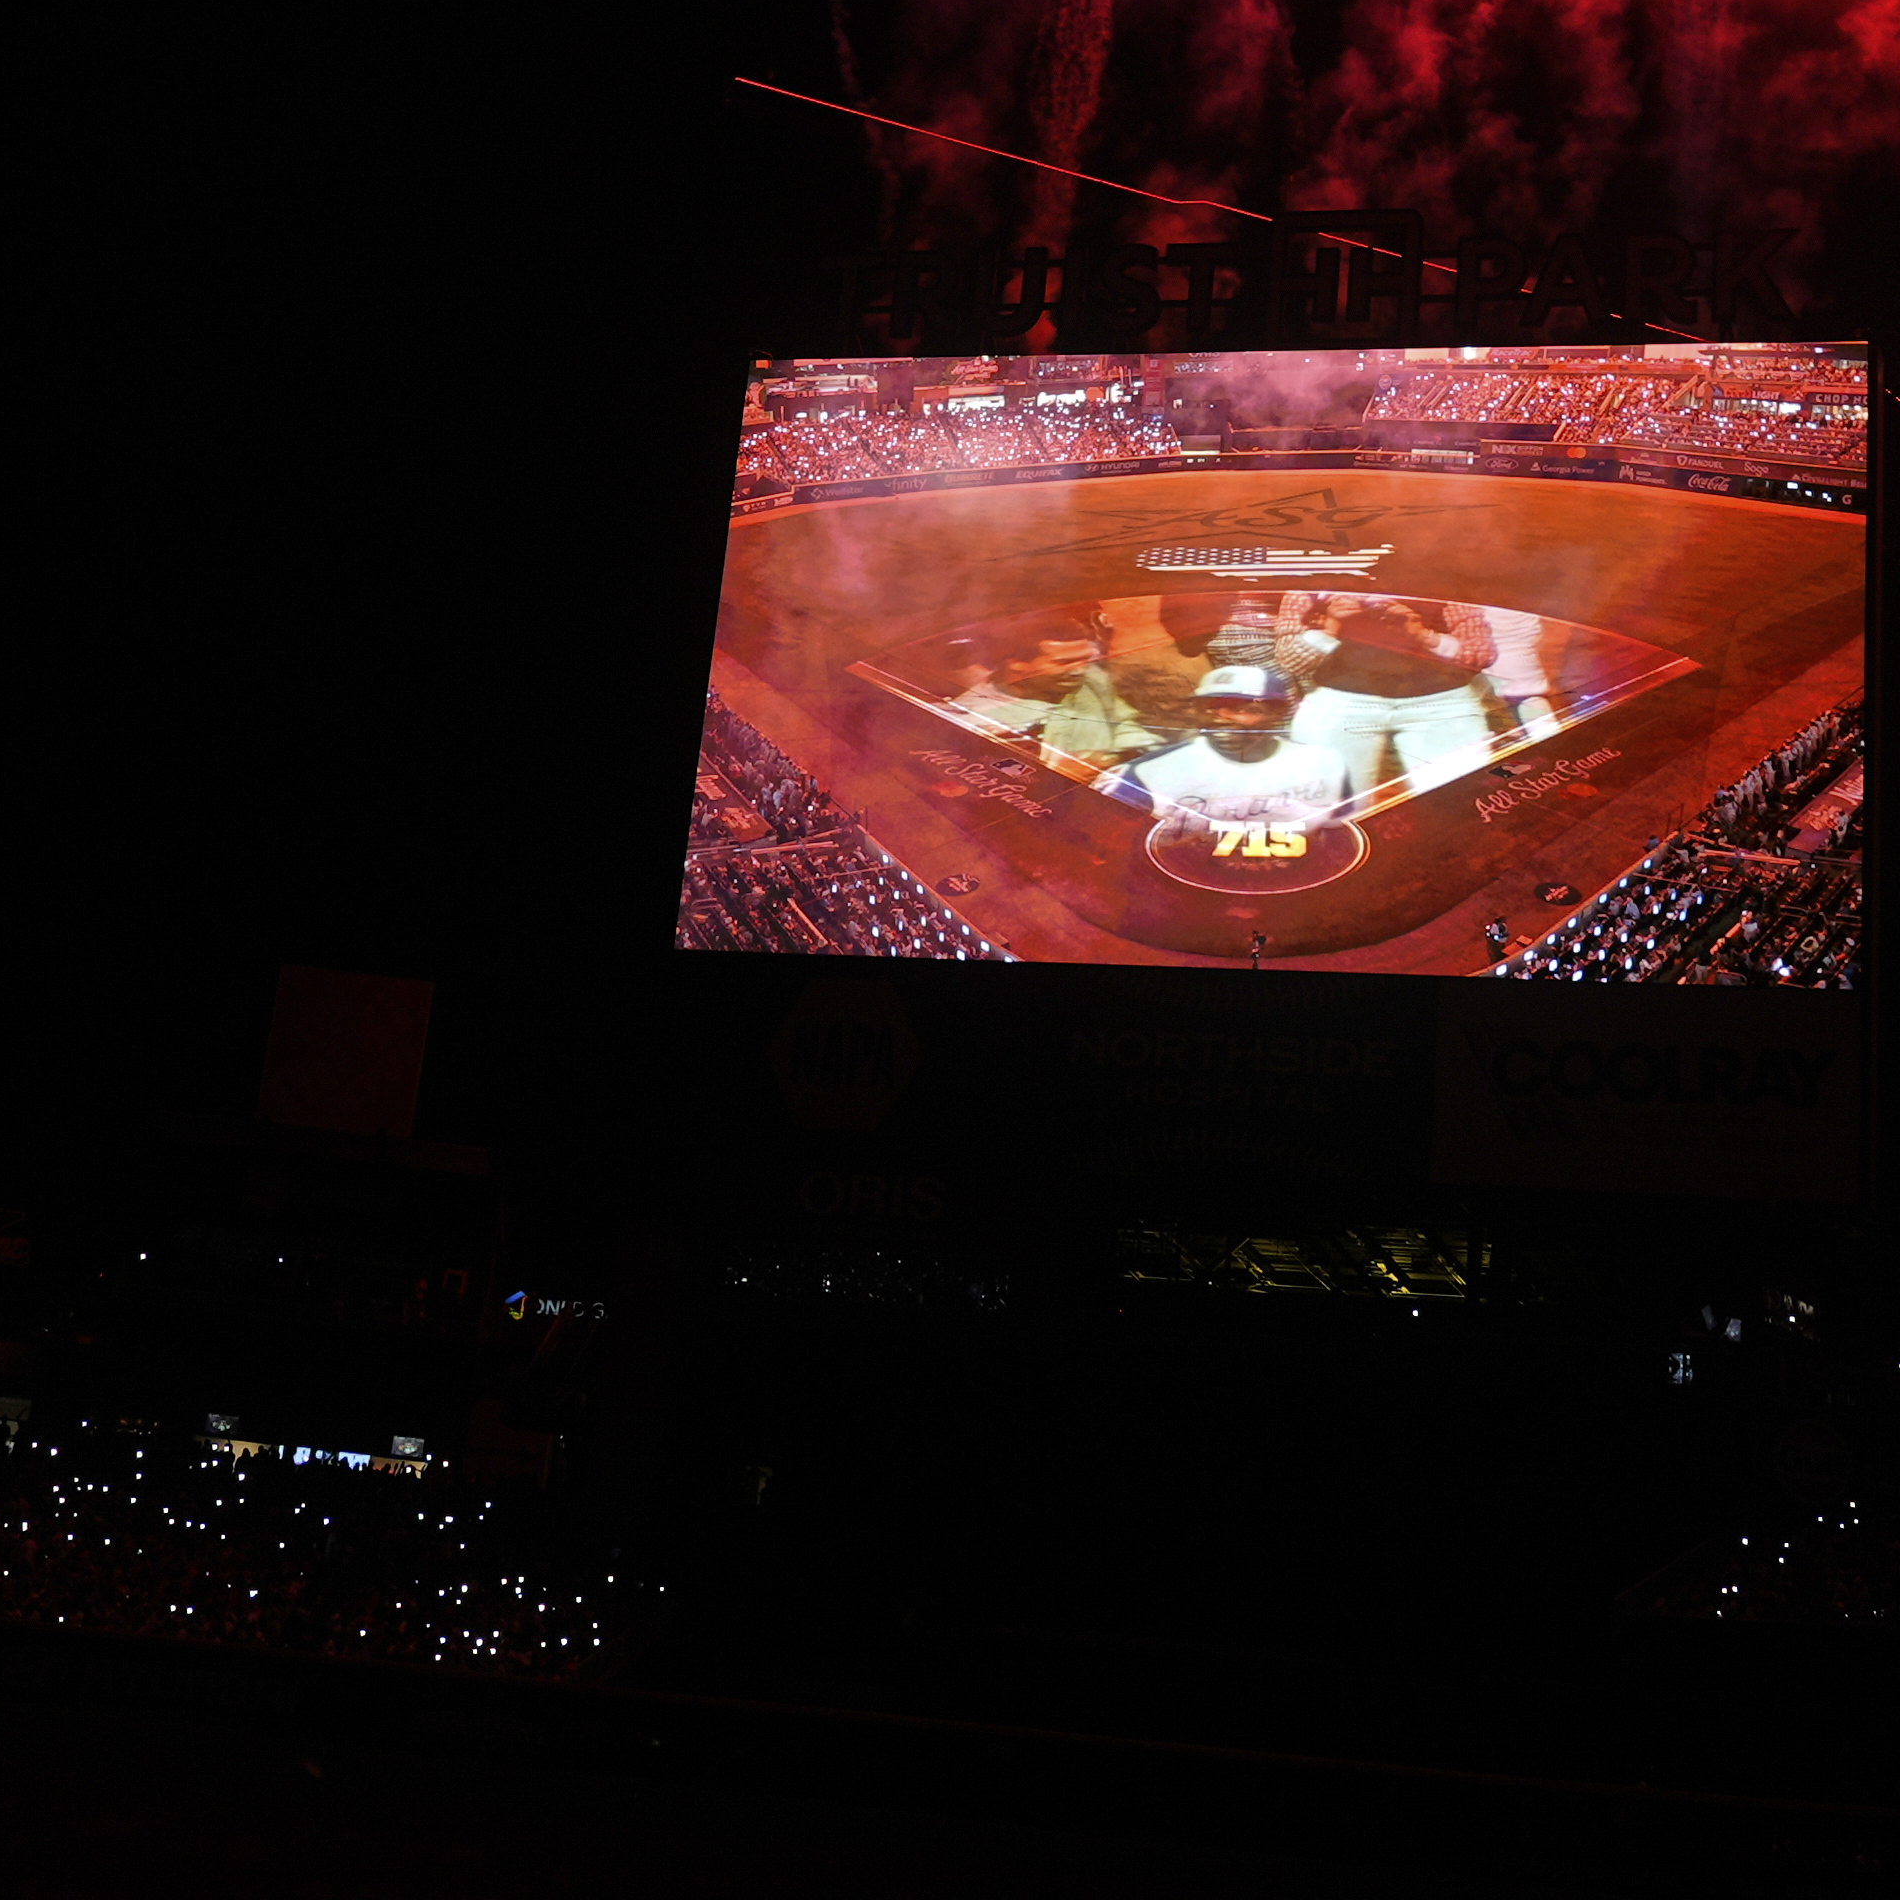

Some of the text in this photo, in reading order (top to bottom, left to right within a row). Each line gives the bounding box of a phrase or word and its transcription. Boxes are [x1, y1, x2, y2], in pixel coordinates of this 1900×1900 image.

[816, 228, 1805, 338] TRUIST PARK
[1816, 394, 1849, 403] CHOP
[1015, 468, 1063, 480] EQUIFAX
[1542, 463, 1595, 475] Georgia Power
[1555, 747, 1622, 779] Game
[1209, 821, 1307, 857] 715
[1070, 1030, 1398, 1077] NORTHSIDE
[1493, 1037, 1838, 1107] COOLRAY
